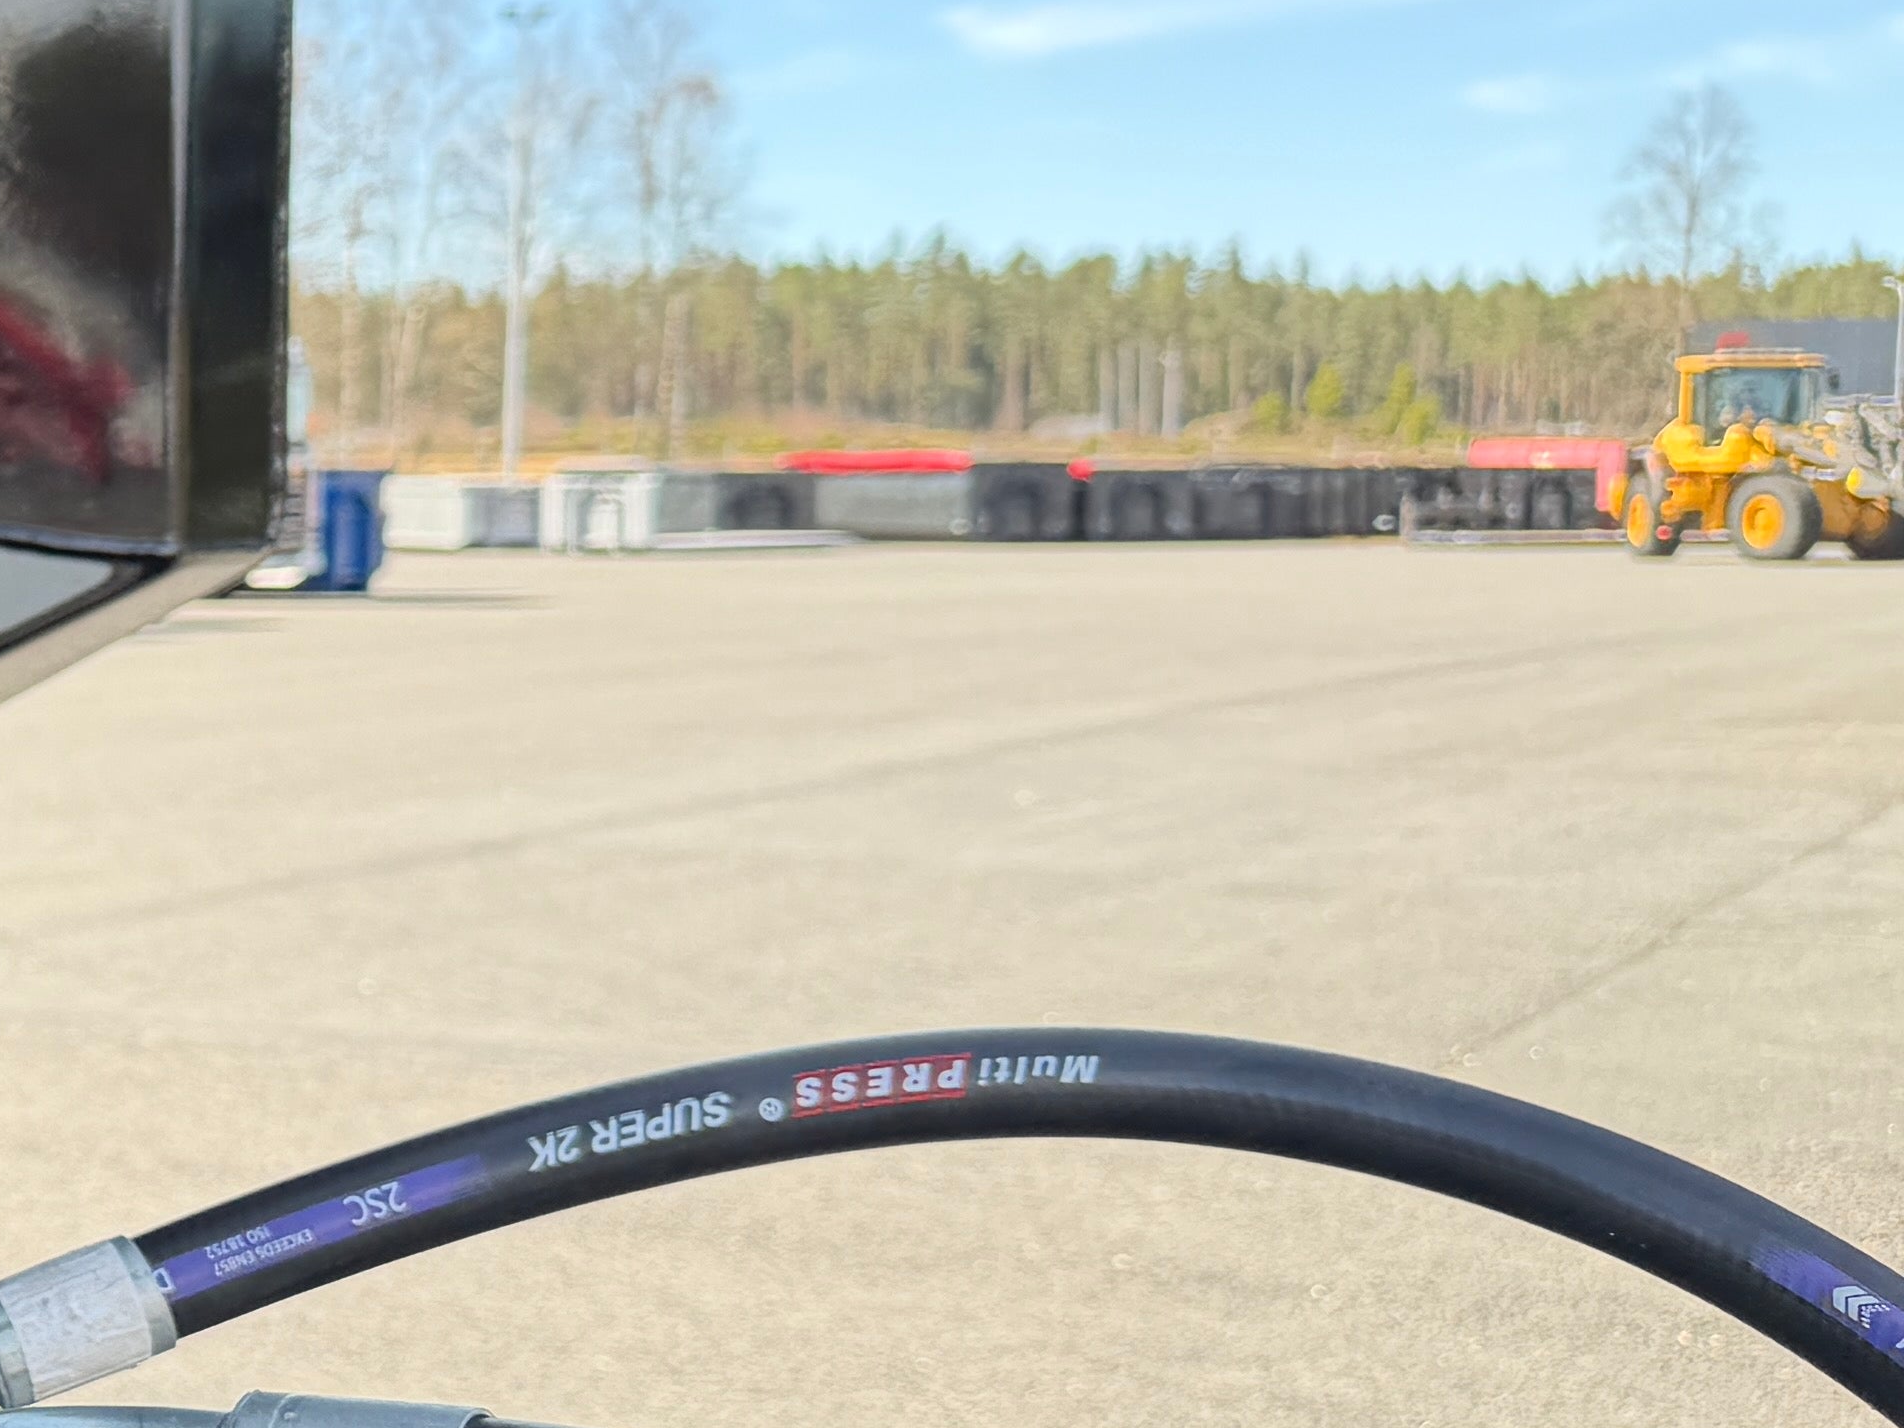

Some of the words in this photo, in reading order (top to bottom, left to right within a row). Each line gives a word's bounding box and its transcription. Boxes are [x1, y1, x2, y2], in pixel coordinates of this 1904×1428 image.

[589, 1091, 734, 1154] SUPER
[527, 1125, 581, 1172] 2K
[343, 1181, 407, 1226] 2SC
[247, 1225, 269, 1244] ISO
[256, 1228, 314, 1260] EXCEEDS
